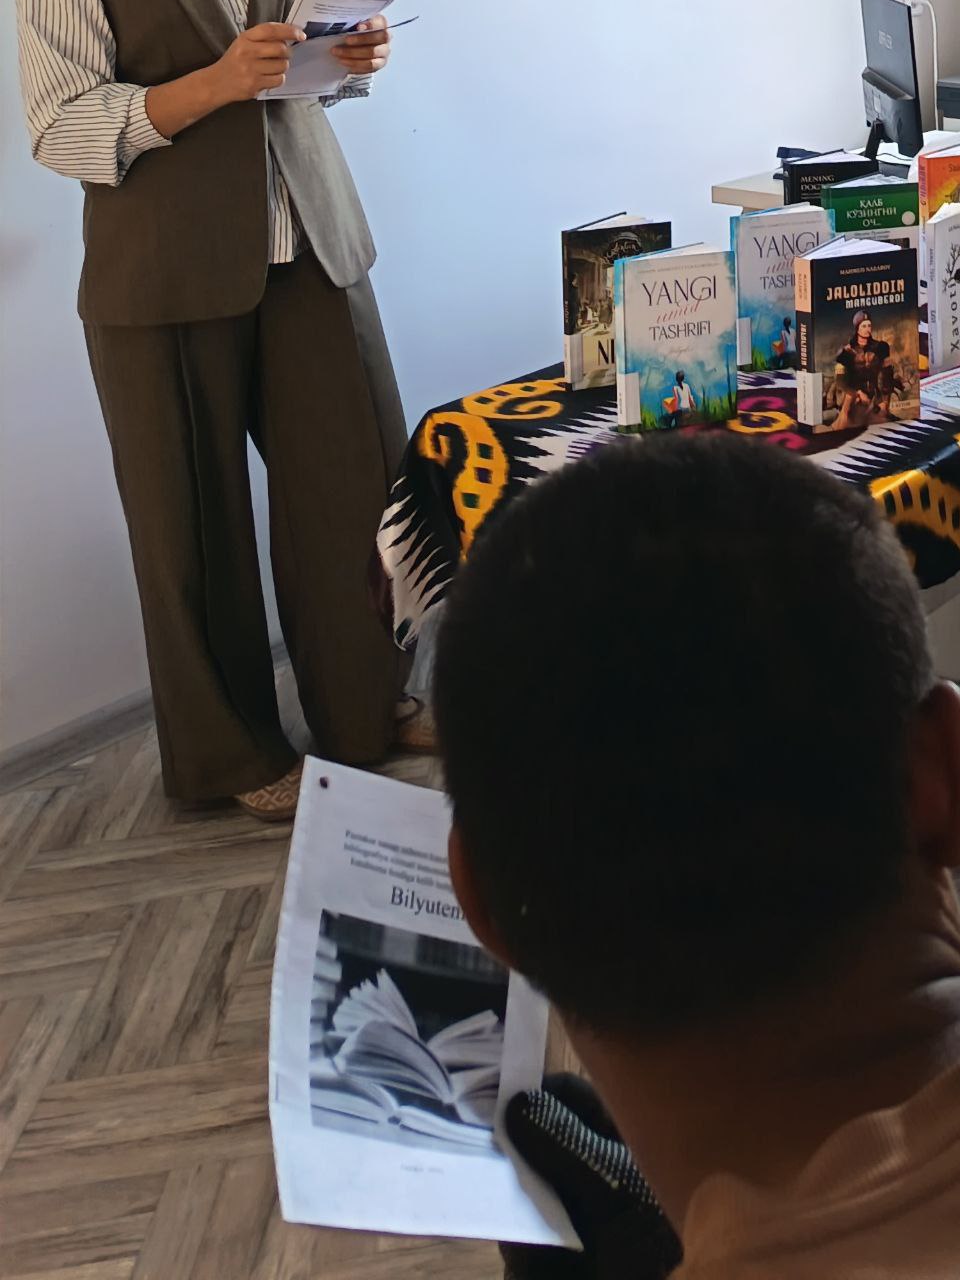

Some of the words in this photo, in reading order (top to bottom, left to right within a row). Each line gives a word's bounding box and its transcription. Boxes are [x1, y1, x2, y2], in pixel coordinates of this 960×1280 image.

[800, 175, 835, 183] MENING
[753, 231, 820, 260] YANGI
[641, 274, 717, 308] YANGI
[826, 278, 905, 301] JALOLIDDIN
[648, 320, 711, 341] TASHRIFI
